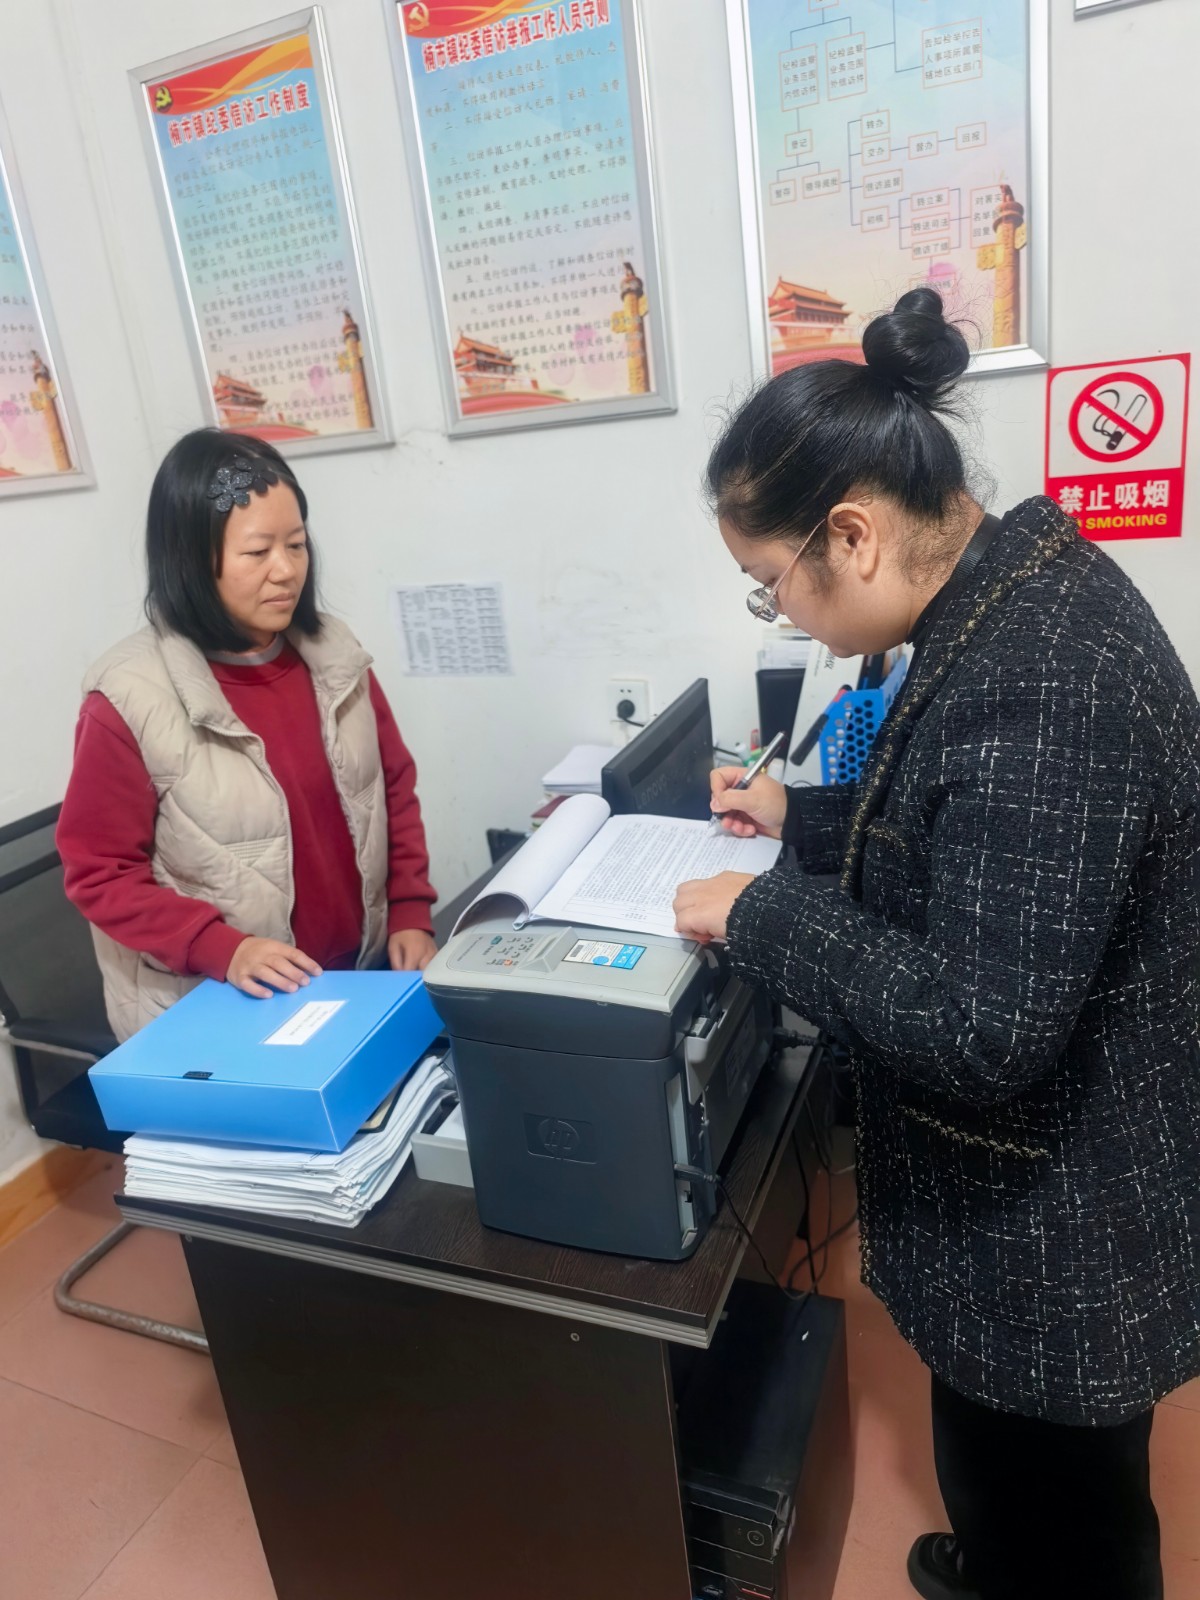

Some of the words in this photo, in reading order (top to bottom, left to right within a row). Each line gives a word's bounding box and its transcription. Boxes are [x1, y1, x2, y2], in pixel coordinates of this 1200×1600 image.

[1058, 480, 1170, 513] 禁止吸烟
[1085, 513, 1167, 530] SMOKING
